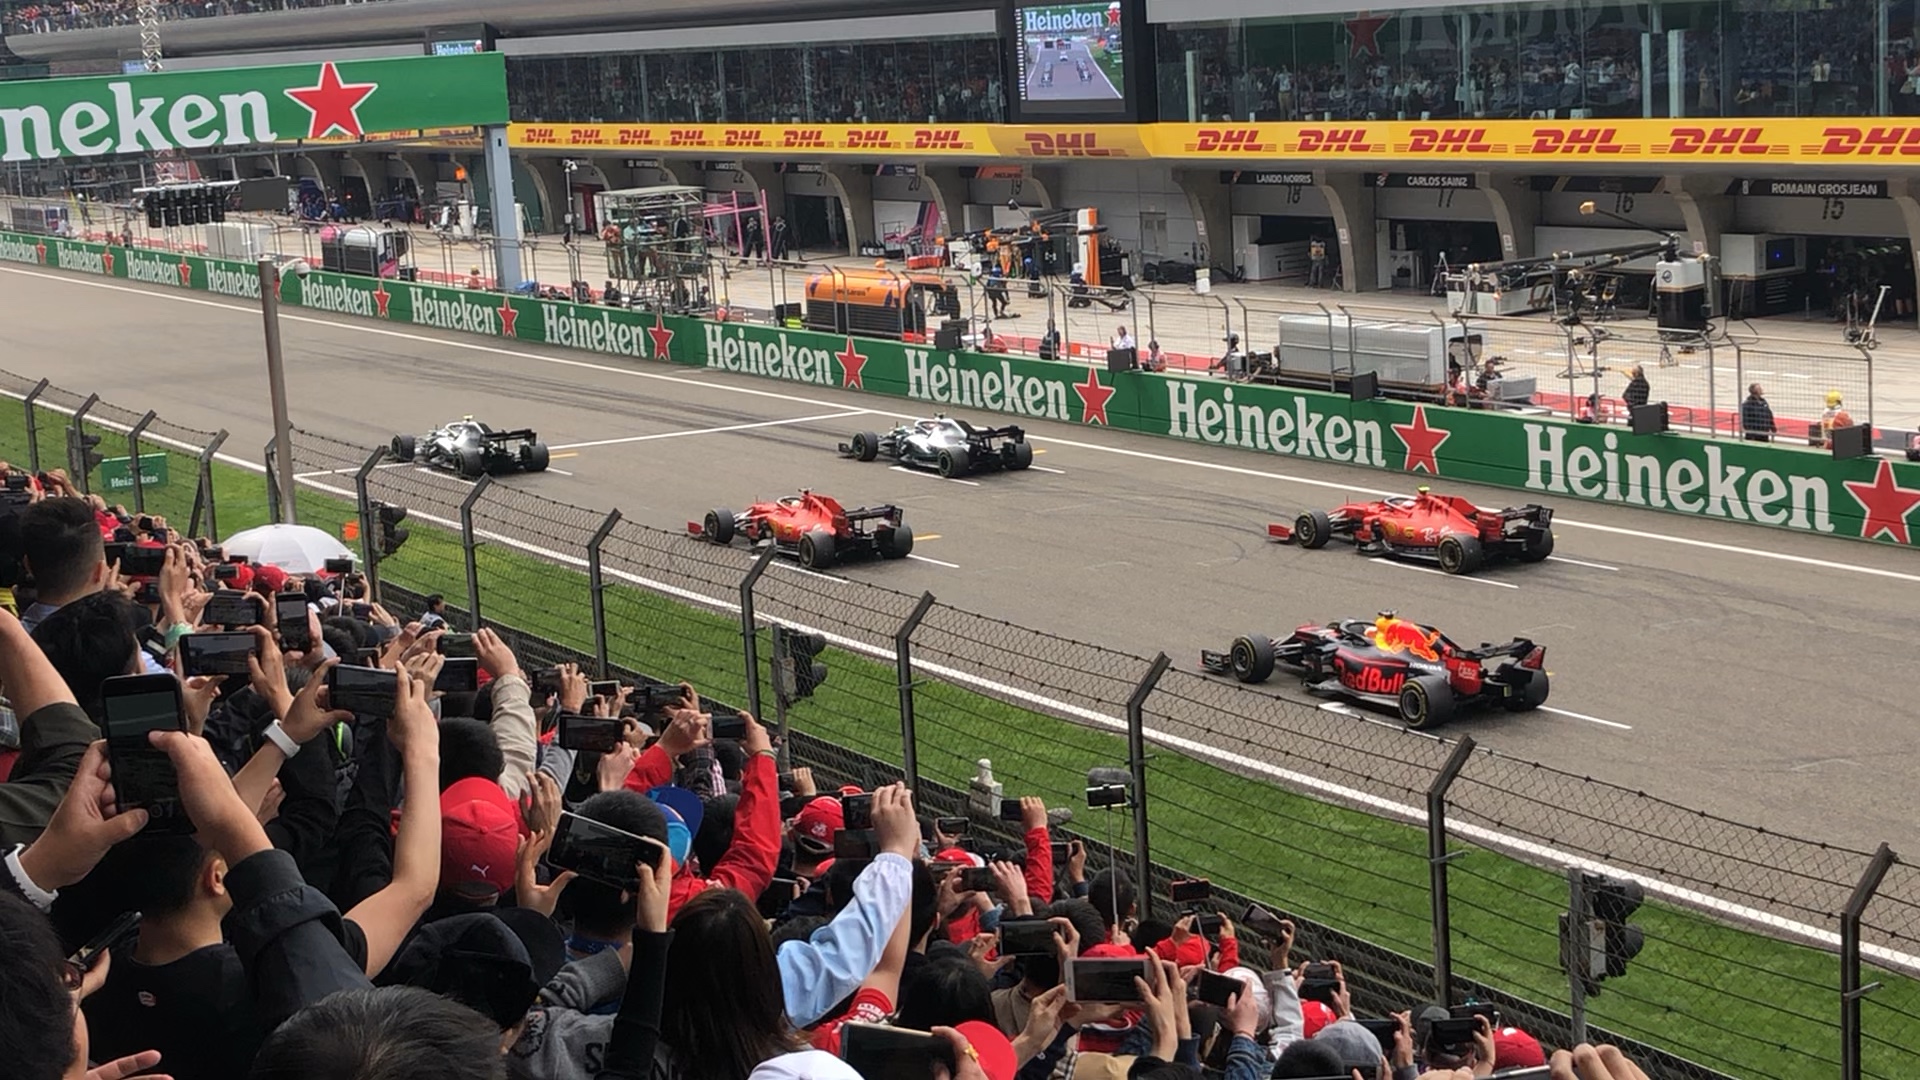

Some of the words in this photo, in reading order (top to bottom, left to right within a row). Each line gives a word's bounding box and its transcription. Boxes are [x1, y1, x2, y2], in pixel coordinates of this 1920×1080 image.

[1025, 9, 1104, 31] Heineken
[525, 128, 557, 144] DHL
[570, 129, 603, 145] DHL
[619, 129, 653, 145] DHL
[670, 130, 707, 146] DHL
[724, 130, 764, 147] DHL
[783, 130, 826, 148] DHL
[847, 130, 892, 149] DHL
[914, 130, 964, 149] DHL
[1025, 133, 1110, 156] DHL
[1197, 130, 1264, 152] DHL
[1297, 129, 1373, 152] DHL
[1408, 129, 1491, 152] DHL
[1531, 129, 1623, 154] DHL
[1668, 128, 1769, 154] DHL
[1821, 127, 1920, 155] DHL
[1256, 174, 1282, 184] LANDO
[1283, 174, 1312, 184] NORRIS
[1407, 176, 1441, 186] CARLOS
[1441, 177, 1468, 187] SAINZ
[1771, 183, 1816, 195] ROMAIN
[1818, 183, 1878, 196] GROSJEAN
[56, 241, 104, 274] Heineken
[125, 250, 179, 286] Heineken
[205, 260, 262, 299] Heineke
[301, 274, 373, 316] Heineken
[409, 286, 497, 335] Heineken
[542, 303, 647, 358] Heineken
[704, 323, 834, 385] Heineken
[904, 349, 1070, 421] Heineken
[1166, 380, 1386, 468] Heineken
[1523, 422, 1835, 533] Heineken
[1409, 662, 1443, 672] HONDA
